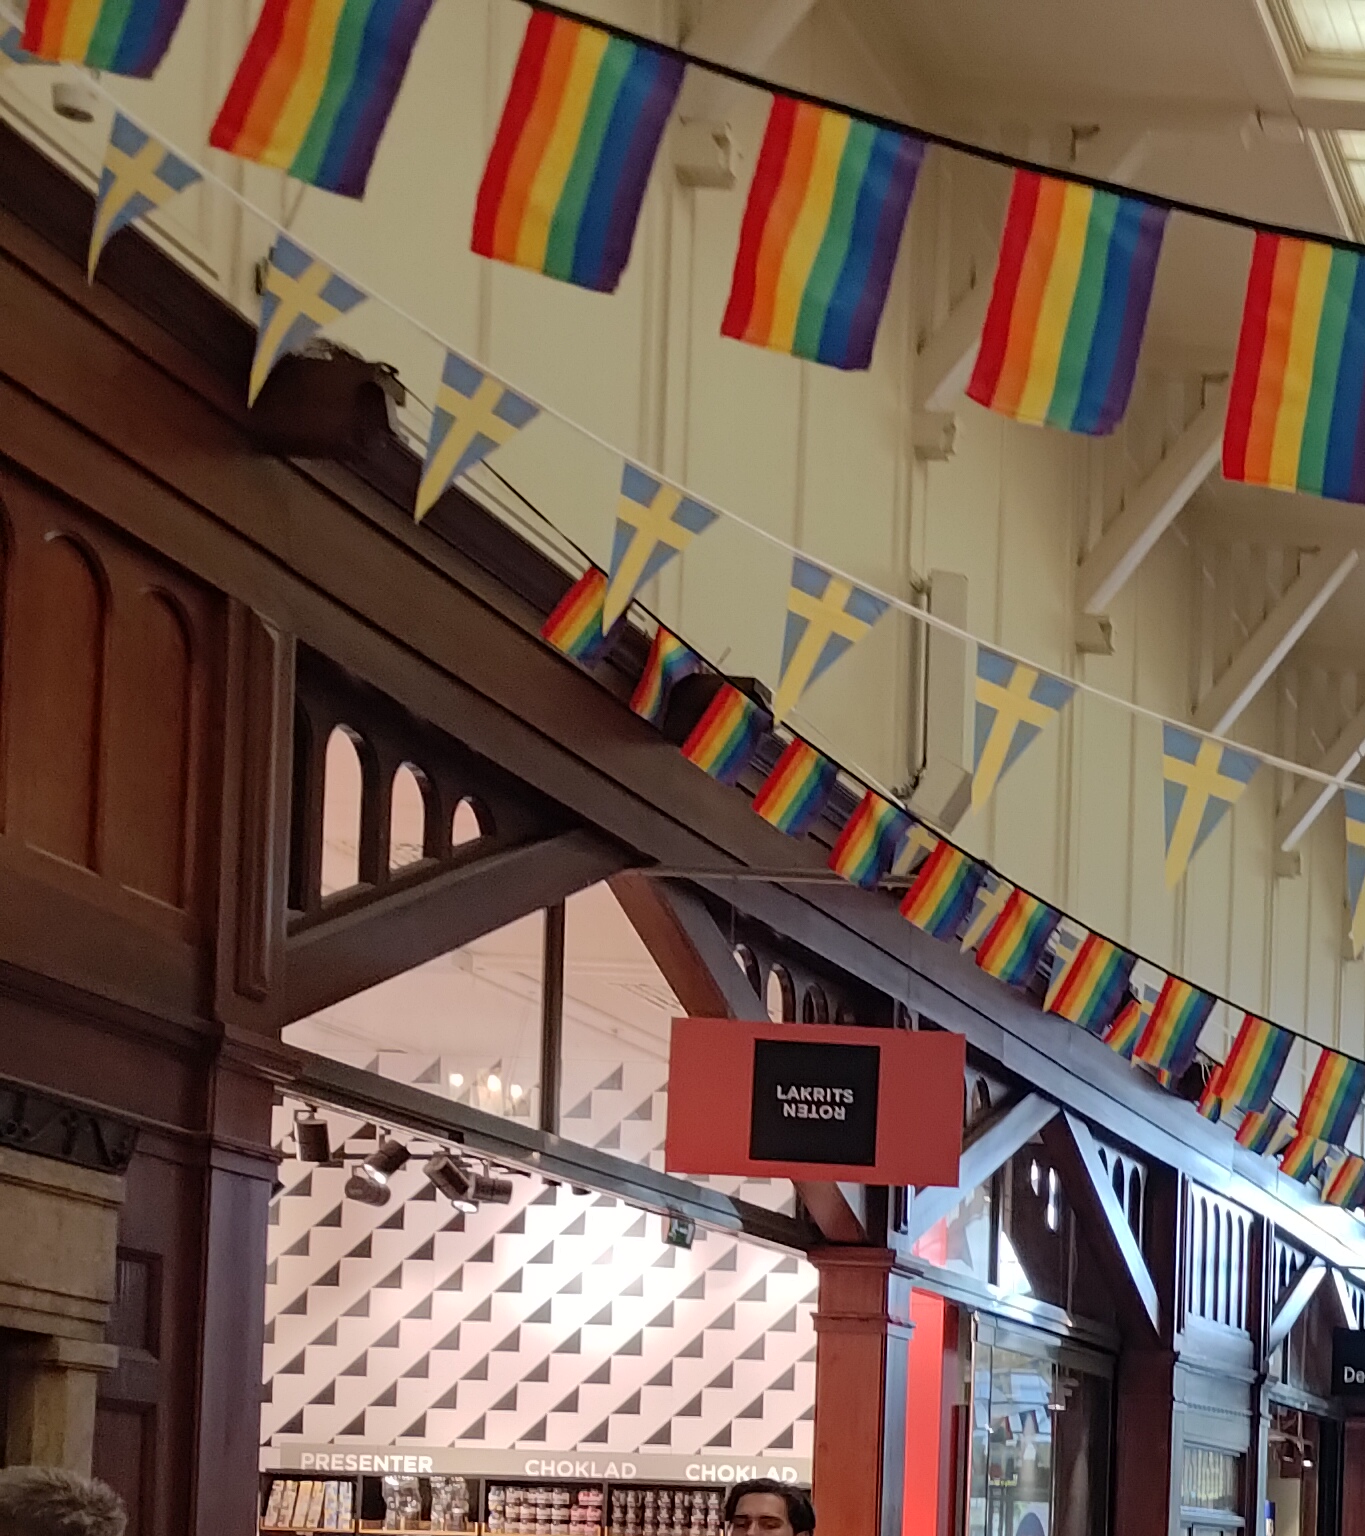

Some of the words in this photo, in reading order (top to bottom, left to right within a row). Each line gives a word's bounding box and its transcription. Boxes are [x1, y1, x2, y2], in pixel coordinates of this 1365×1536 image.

[776, 1084, 854, 1103] LAKRITS
[783, 1102, 846, 1121] ROTEN
[301, 1452, 433, 1473] PRESENTER
[524, 1459, 637, 1479] CHOKLAD
